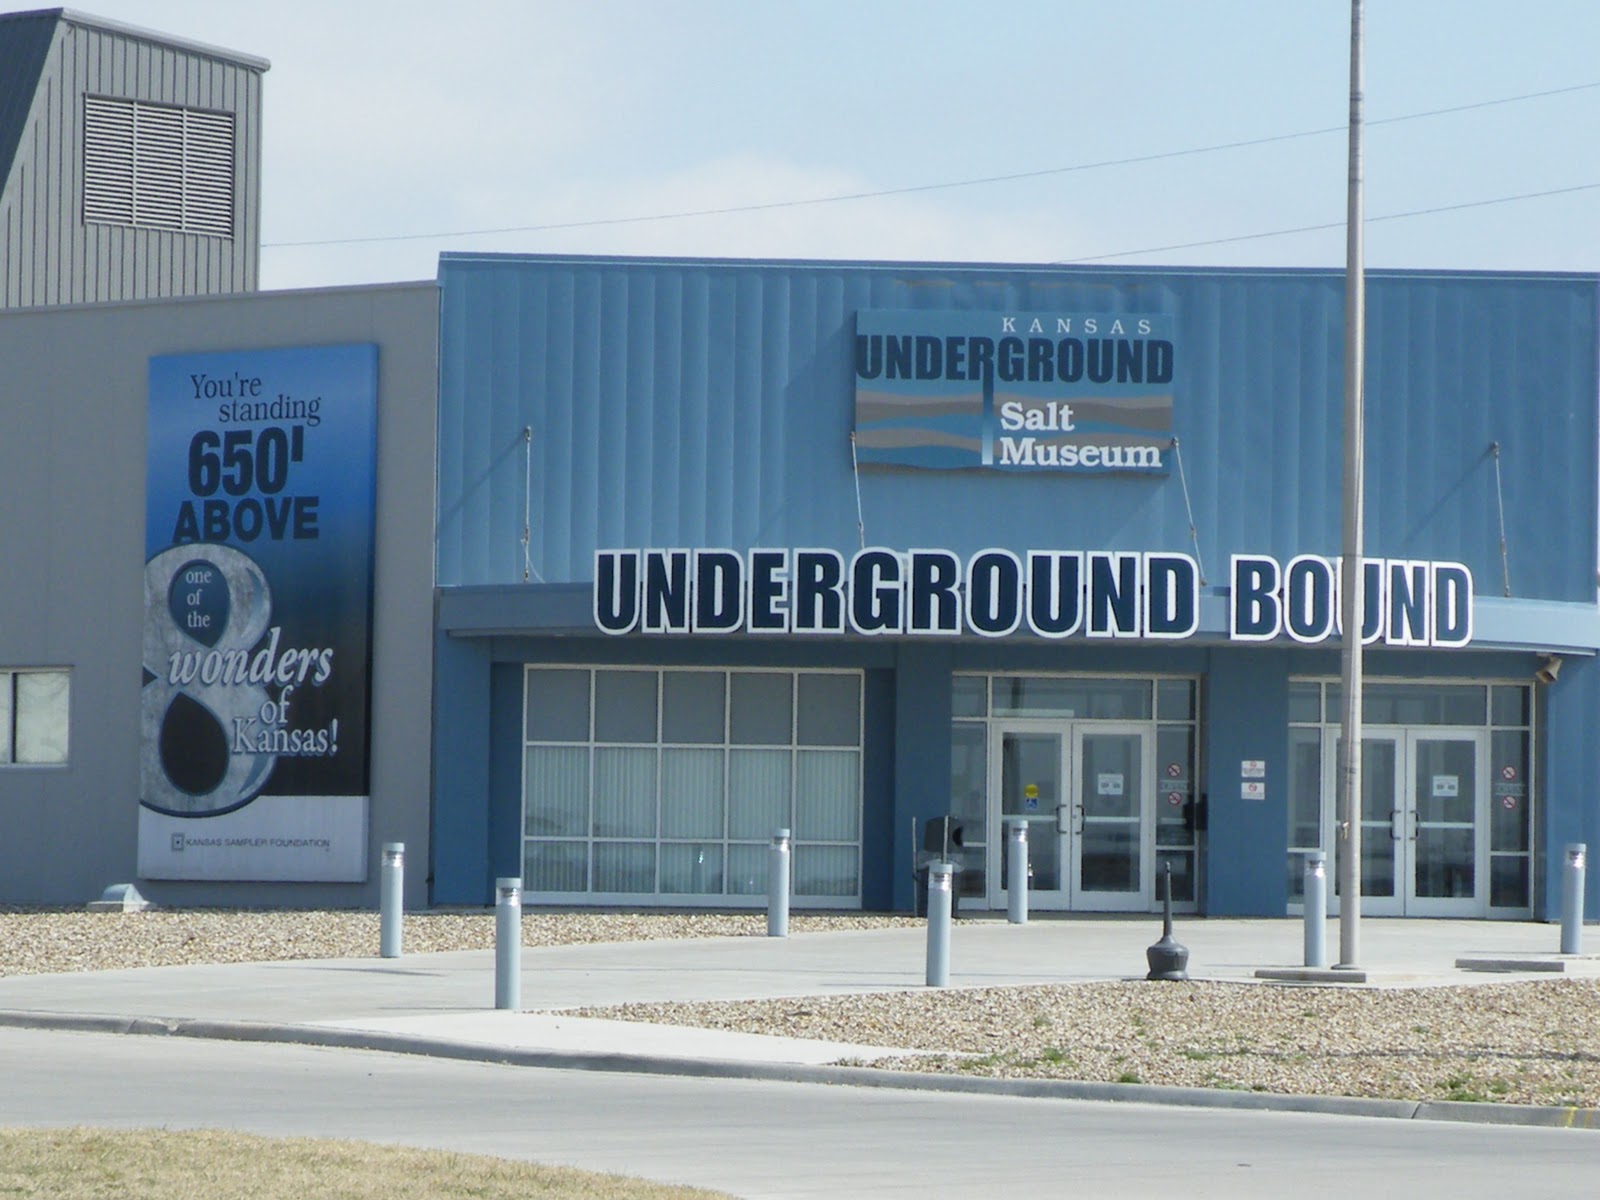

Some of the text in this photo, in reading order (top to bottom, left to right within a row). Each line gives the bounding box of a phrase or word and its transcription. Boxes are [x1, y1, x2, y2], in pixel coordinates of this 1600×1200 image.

[1001, 317, 1151, 335] KANSAS
[855, 335, 1174, 384] UNDERGROUND
[190, 371, 262, 399] You're
[219, 394, 322, 427] standing
[1000, 401, 1075, 431] Salt
[188, 425, 305, 497] 650'
[999, 437, 1162, 467] Museum
[172, 496, 320, 544] ABOVE
[185, 569, 212, 584] one
[187, 589, 203, 606] of
[594, 546, 1474, 648] UNDERGROUND BOUND
[187, 611, 210, 628] the
[168, 626, 334, 687] wonders
[259, 685, 294, 725] of
[232, 717, 339, 756] Kansas!
[186, 838, 330, 848] KANSAS SAMPLER FOUNDATION
